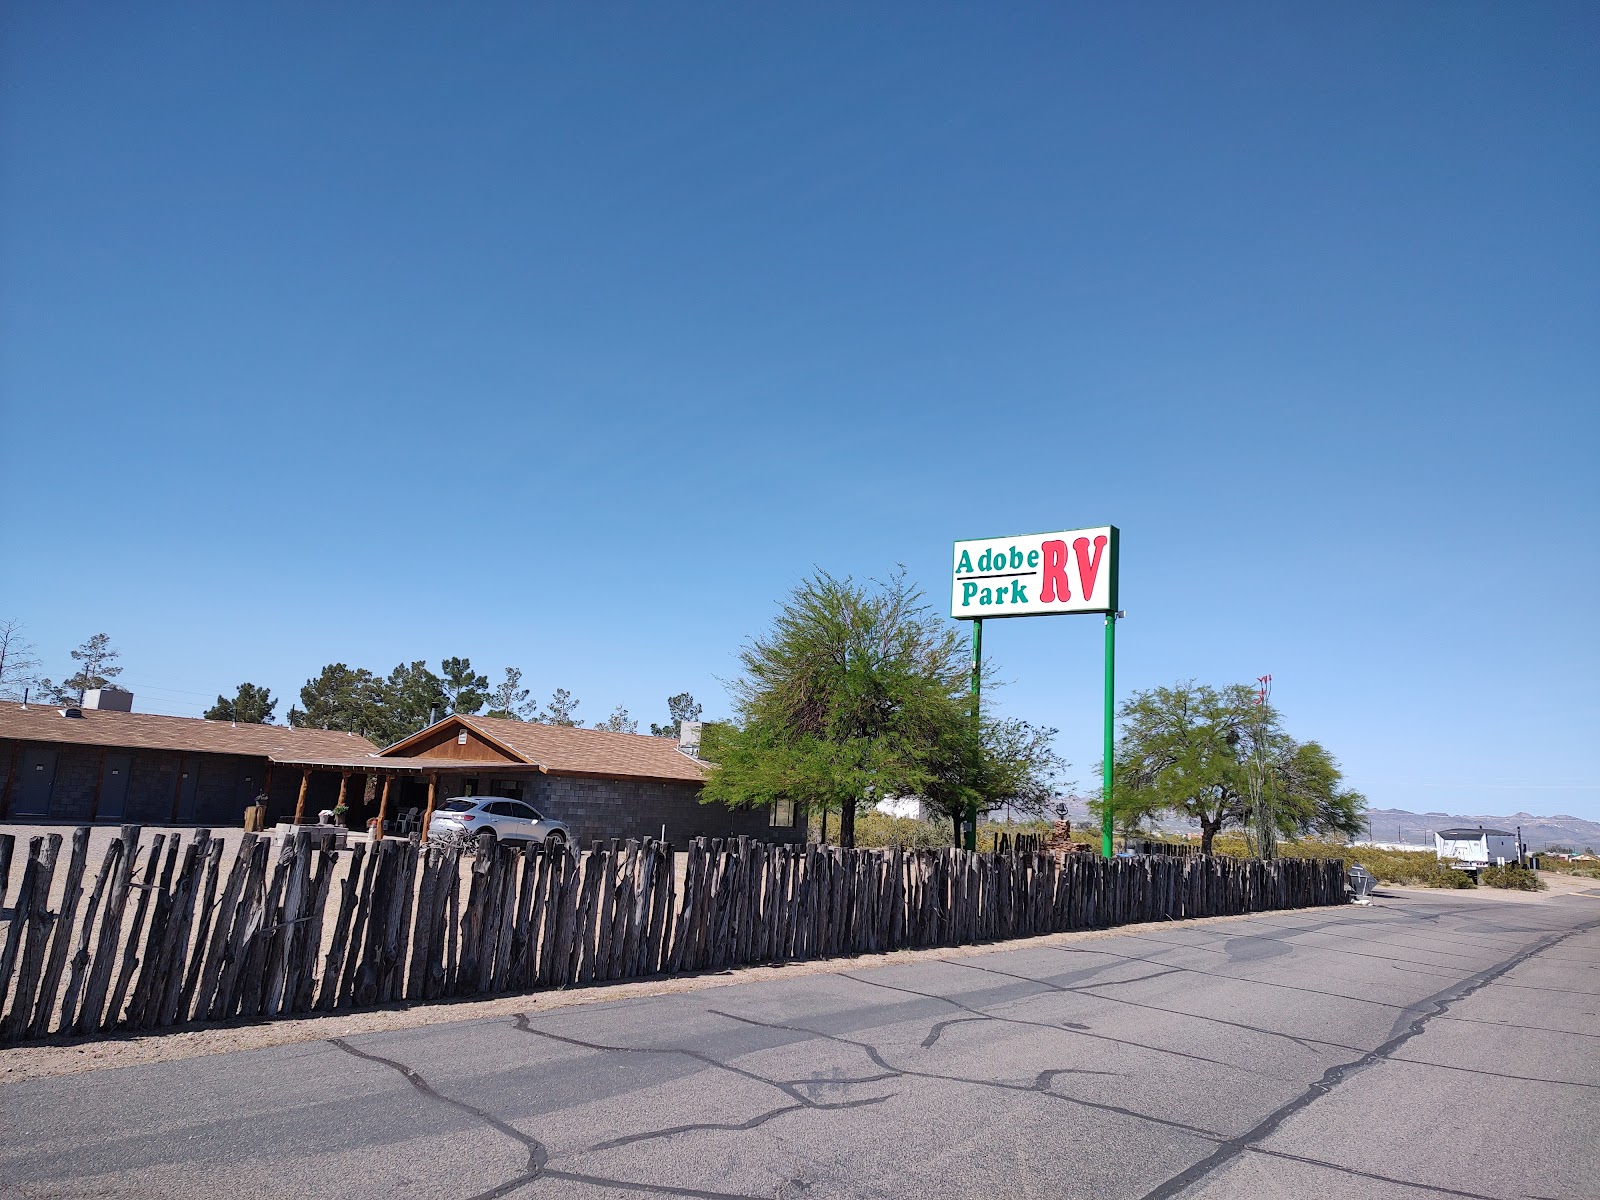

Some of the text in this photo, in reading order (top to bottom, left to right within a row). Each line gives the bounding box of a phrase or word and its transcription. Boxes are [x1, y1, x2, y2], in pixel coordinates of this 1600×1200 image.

[955, 545, 1039, 574] Adobe
[1039, 535, 1108, 603] RV
[961, 579, 1029, 607] Park
